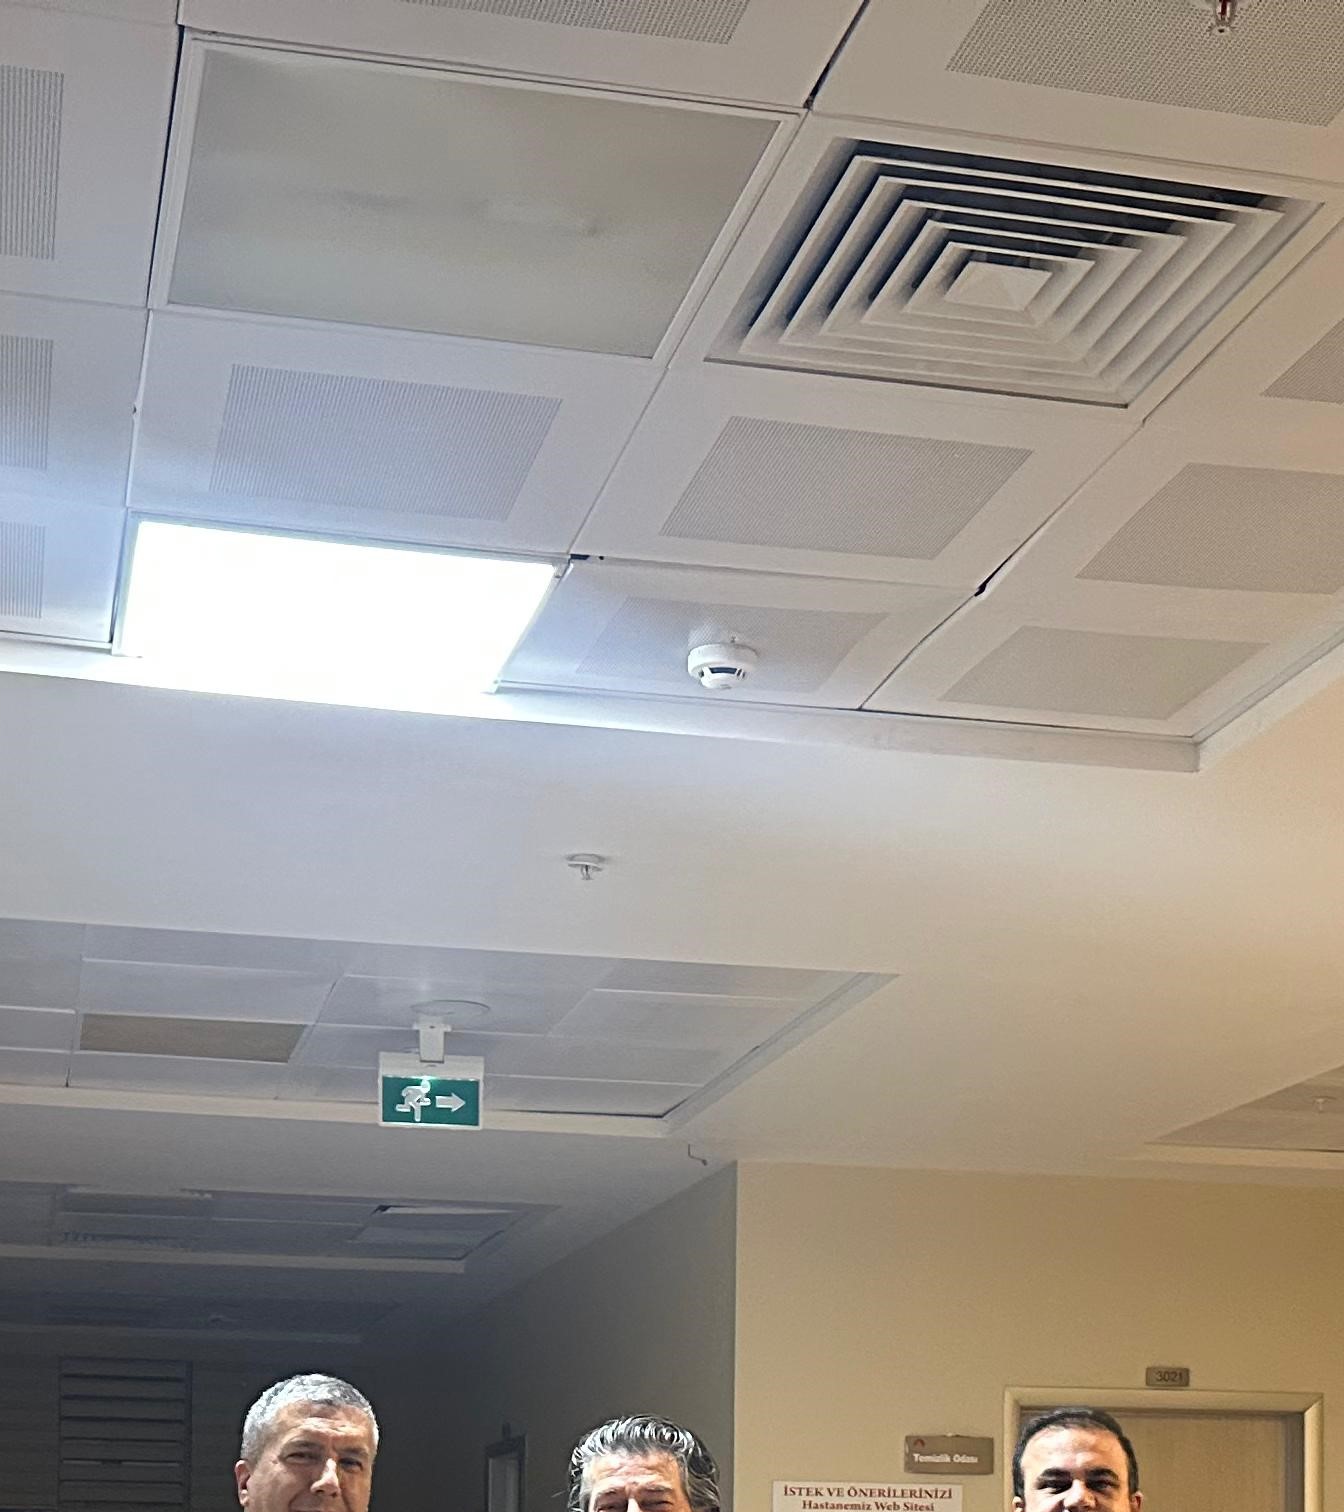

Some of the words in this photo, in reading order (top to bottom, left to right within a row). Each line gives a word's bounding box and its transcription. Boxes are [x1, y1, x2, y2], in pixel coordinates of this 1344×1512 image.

[912, 1453, 951, 1463] Temizlik
[783, 1485, 823, 1497] İSTEK
[827, 1487, 844, 1497] VE
[847, 1486, 953, 1499] ÖNERİLERİNİZİ
[802, 1500, 871, 1511] Hastanemiz
[874, 1501, 900, 1512] Web
[902, 1501, 935, 1512] Sitesi
